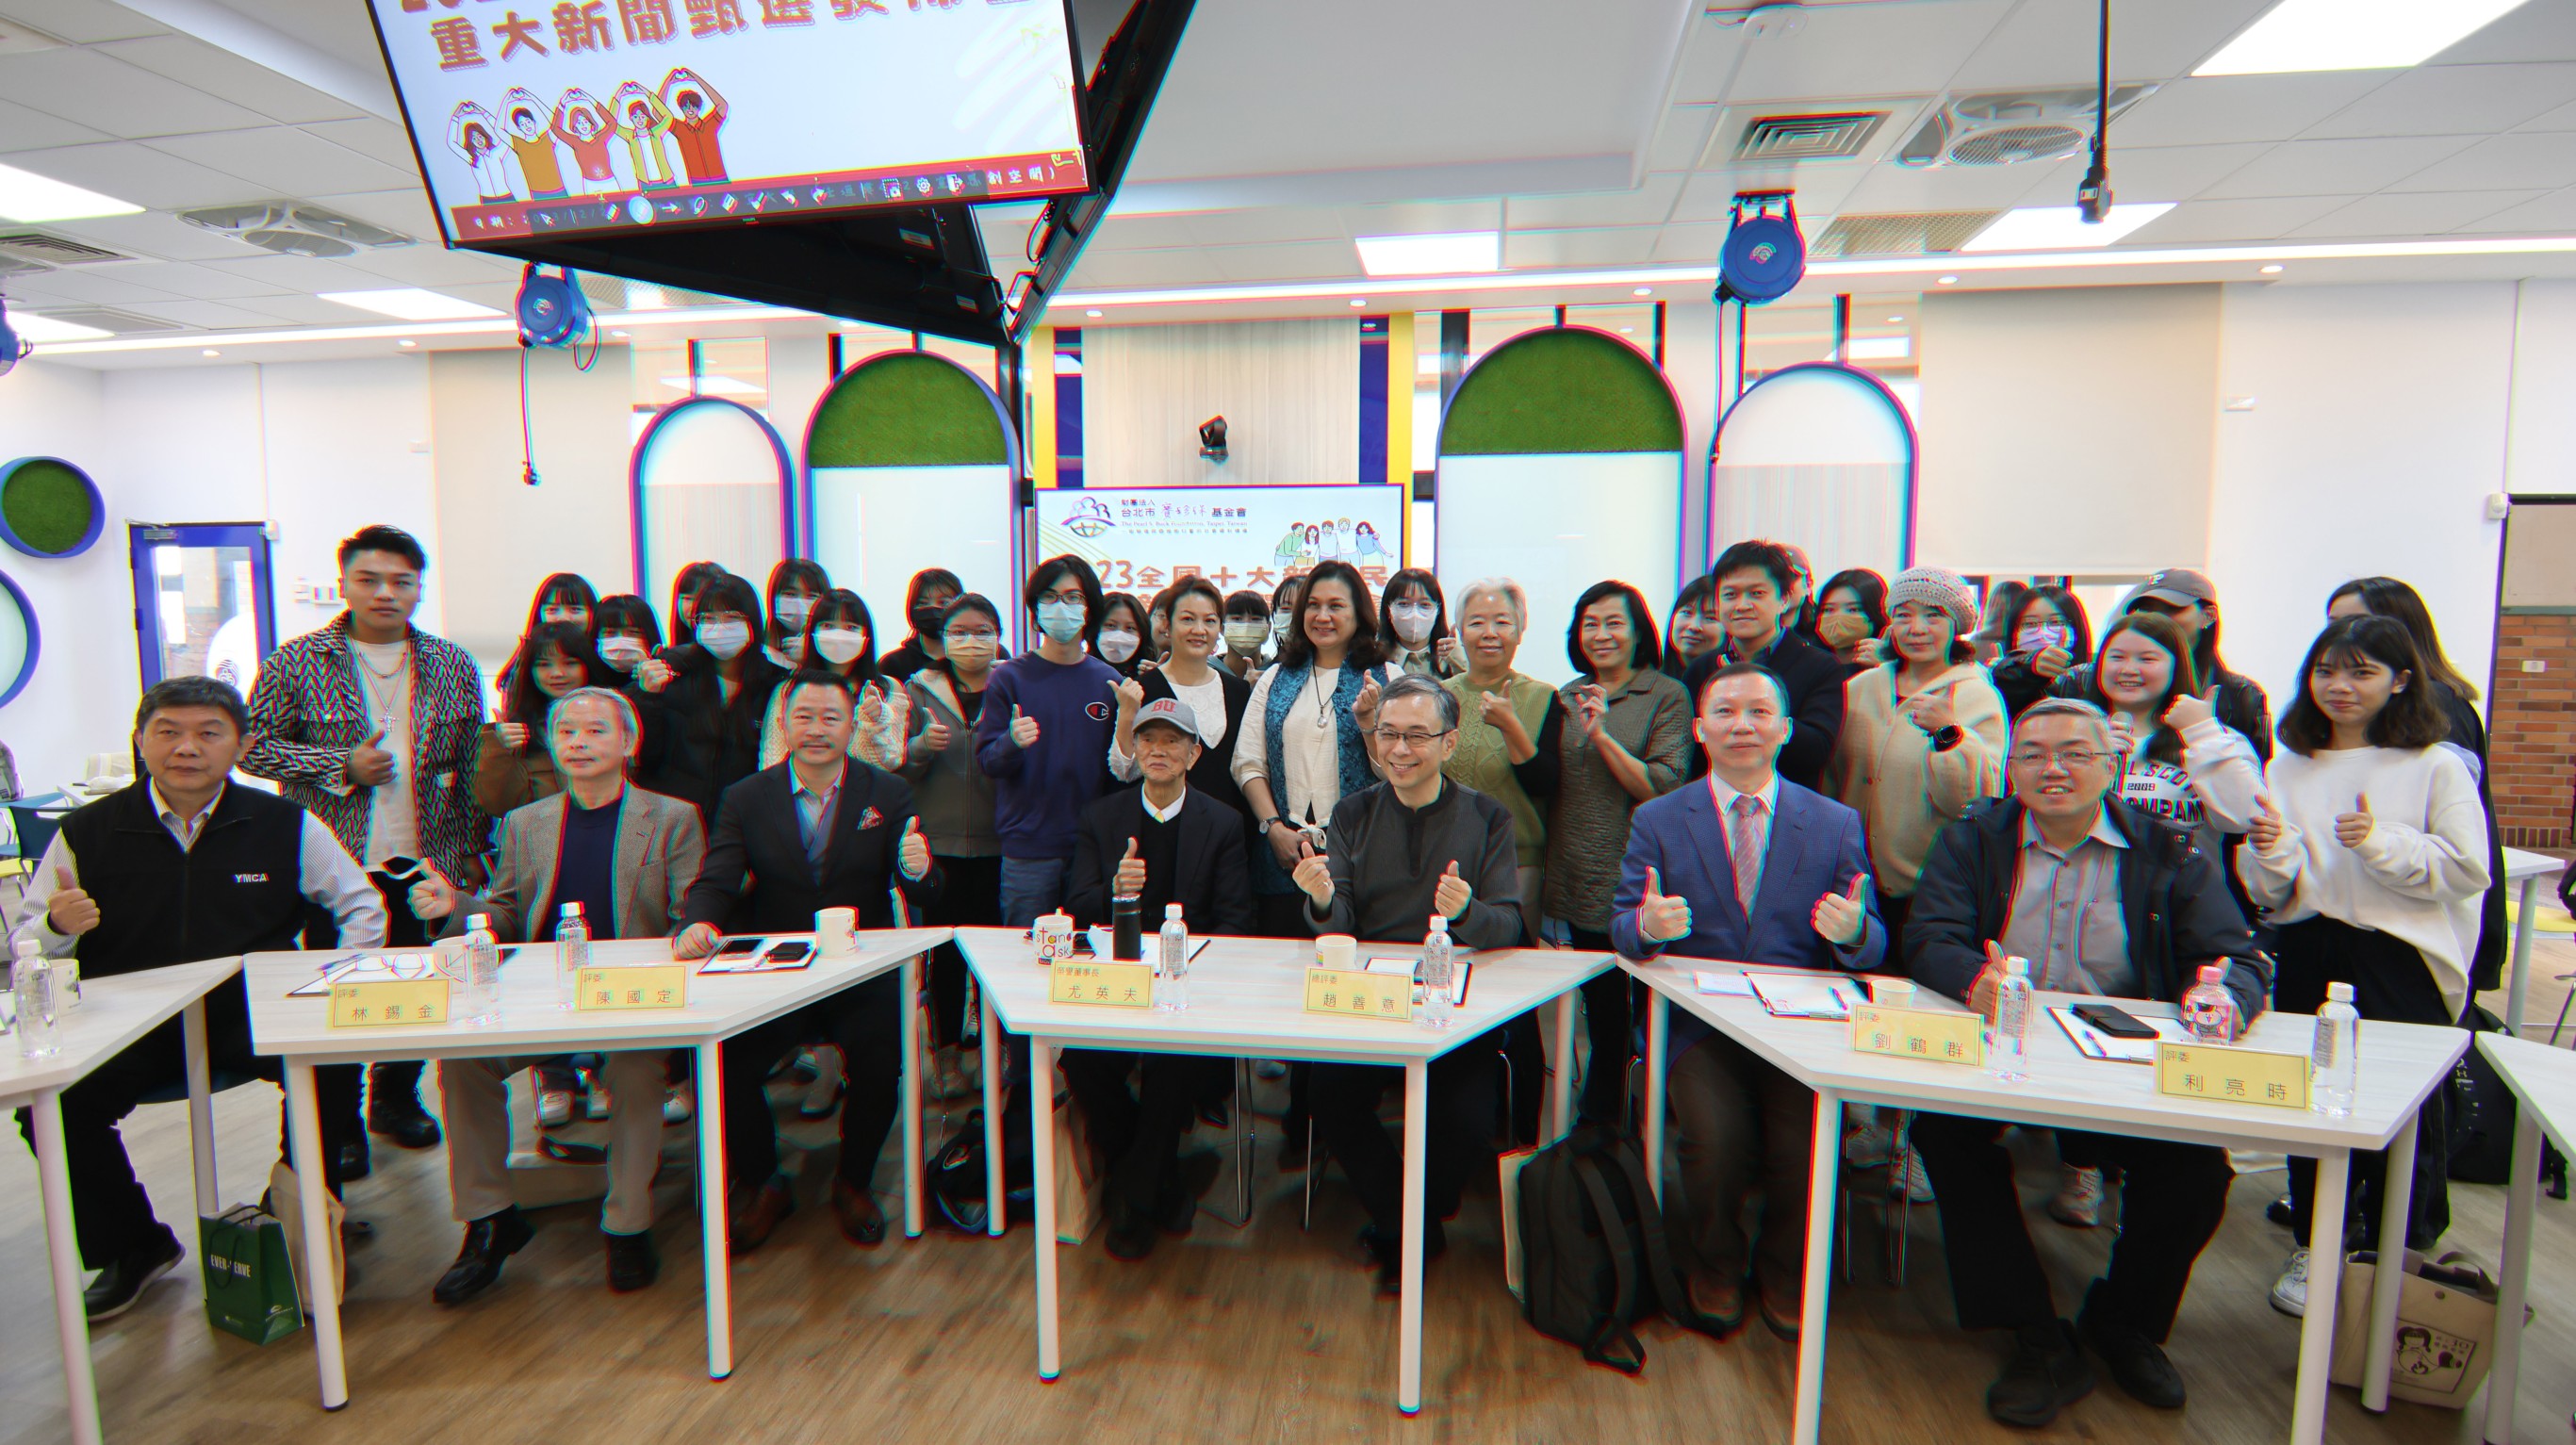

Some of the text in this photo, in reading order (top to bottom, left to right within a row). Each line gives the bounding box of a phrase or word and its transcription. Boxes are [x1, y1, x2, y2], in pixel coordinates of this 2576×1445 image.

[1151, 699, 1176, 713] BU
[234, 873, 270, 883] YMCA
[338, 988, 359, 998] 評委
[597, 990, 671, 1005] 陳國定
[1068, 985, 1137, 1002] 尤英夫
[1322, 993, 1395, 1013] 趙善意
[352, 1004, 433, 1022] 林錫金
[1875, 1032, 1964, 1059] 劉鶴群
[2165, 1049, 2190, 1063] 評委
[2184, 1074, 2288, 1101] 利亮時
[210, 1254, 252, 1278] EVER-ERVE
